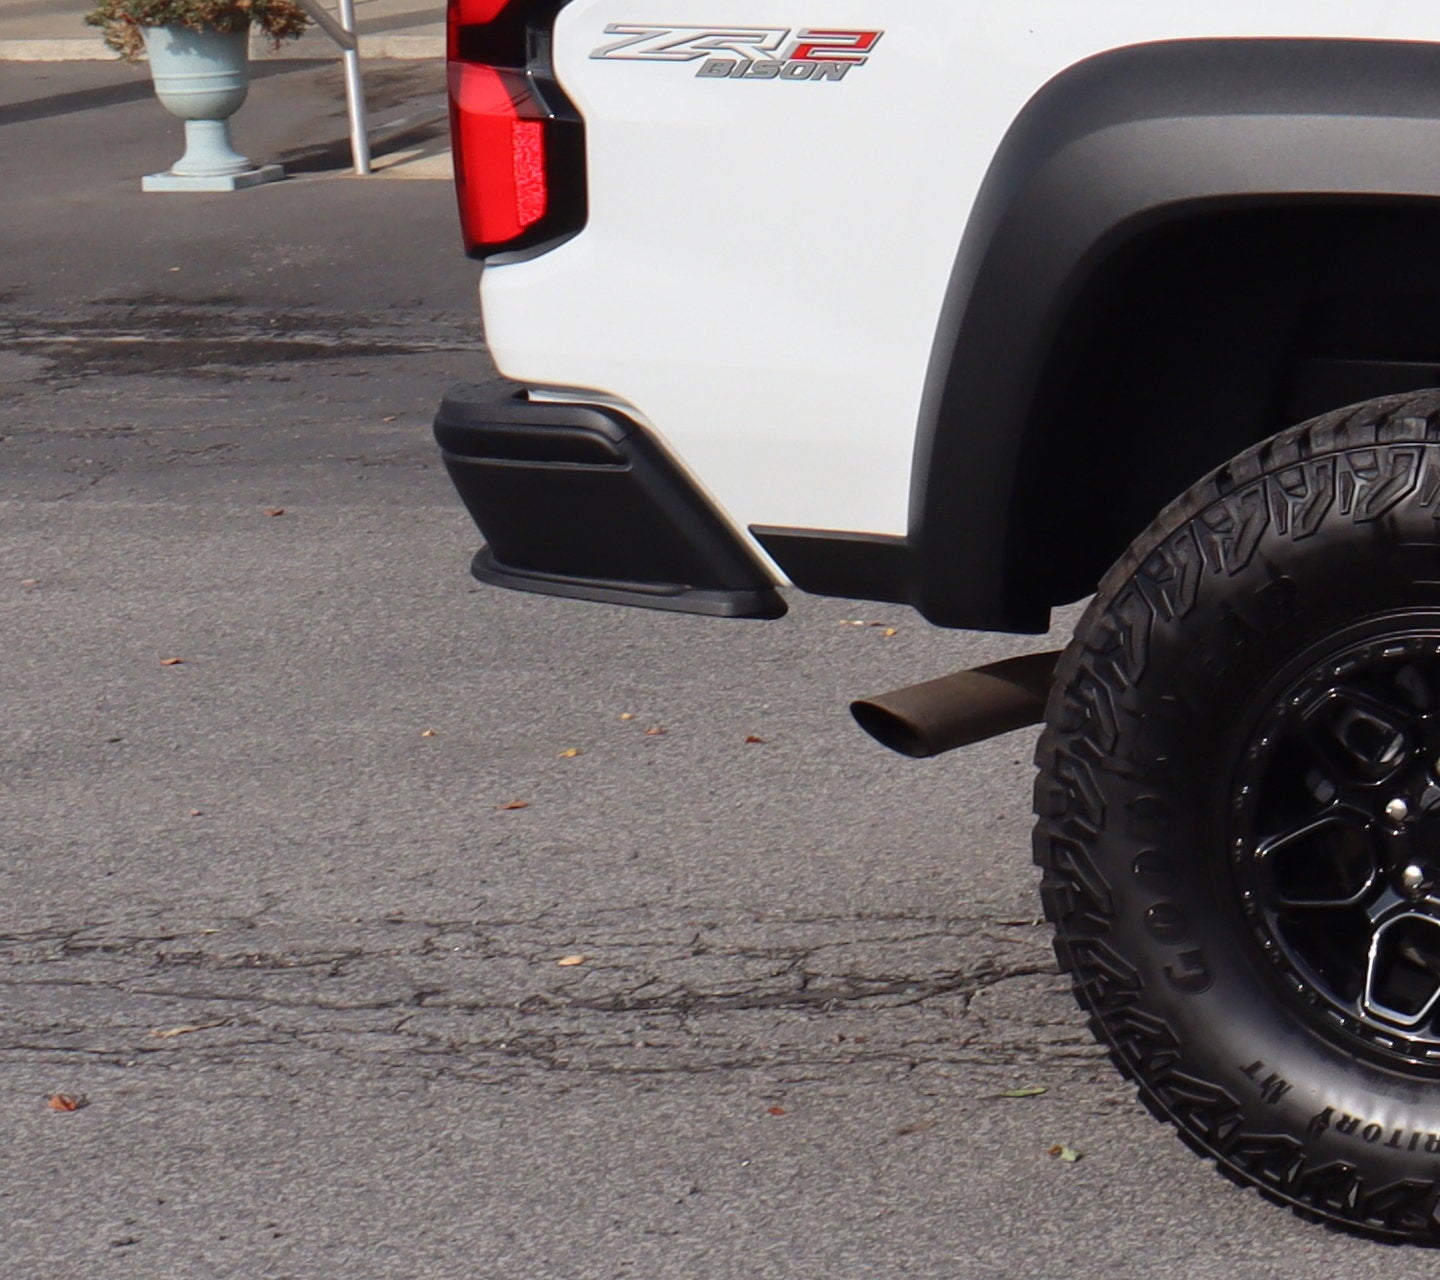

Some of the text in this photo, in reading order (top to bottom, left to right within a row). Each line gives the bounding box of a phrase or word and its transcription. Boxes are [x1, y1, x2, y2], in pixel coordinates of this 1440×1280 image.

[588, 23, 885, 65] ZR2
[695, 59, 852, 81] BISON
[1238, 1059, 1294, 1107] MT
